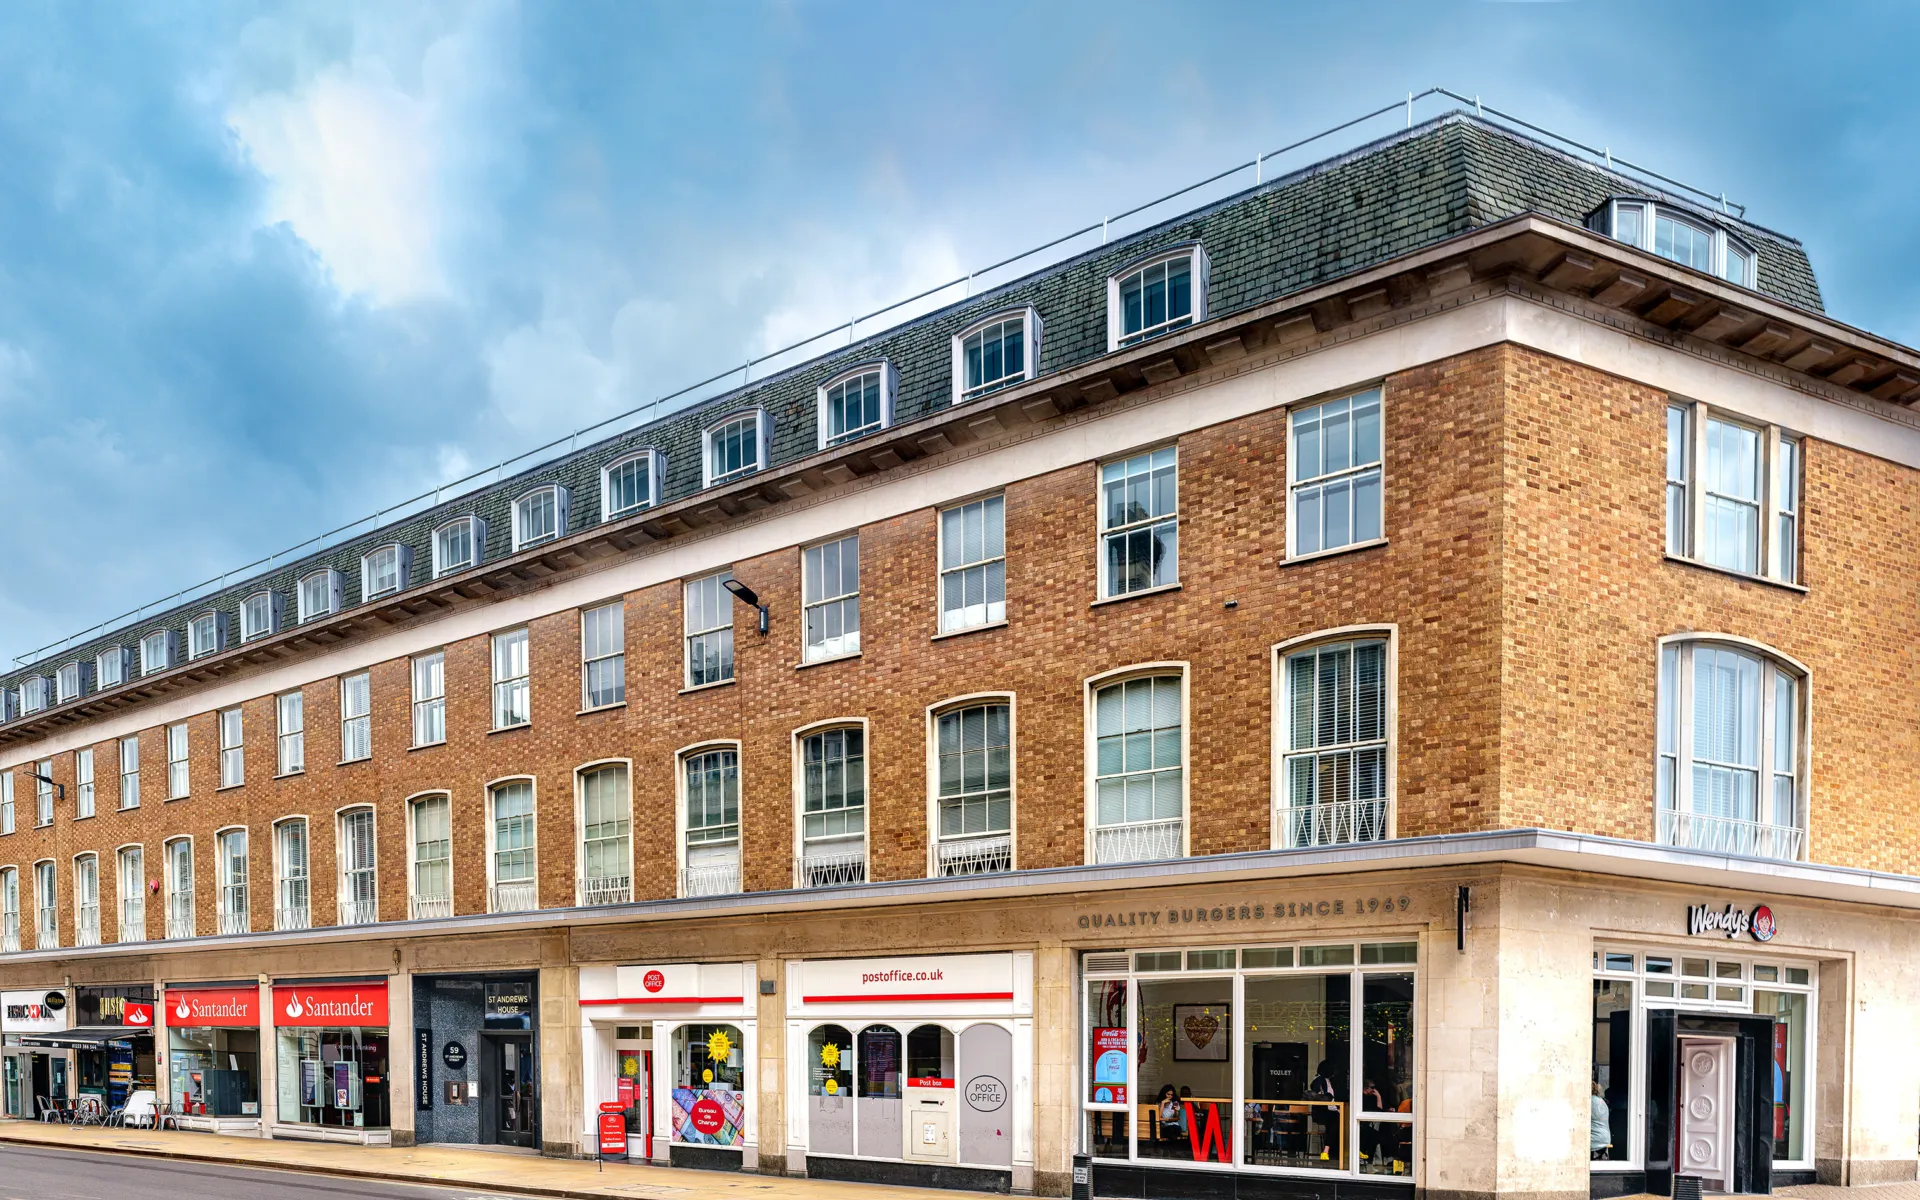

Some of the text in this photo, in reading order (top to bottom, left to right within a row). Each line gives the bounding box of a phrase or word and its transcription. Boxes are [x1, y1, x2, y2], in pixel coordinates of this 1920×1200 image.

[1077, 895, 1411, 929] QUALITY BURGERS SINCE 1969
[1688, 903, 1750, 939] Wendy's
[862, 968, 943, 985] postoffice.co.uk
[488, 995, 528, 1004] ST ANDREWS
[192, 996, 248, 1018] Santander
[305, 993, 374, 1017] Santander
[497, 1005, 519, 1014] HOUSE
[7, 1004, 29, 1018] HSBC
[421, 1032, 427, 1042] ST
[449, 1046, 459, 1054] 59
[975, 1083, 998, 1093] POST
[970, 1093, 1001, 1102] OFFICE
[697, 1119, 718, 1127] Change
